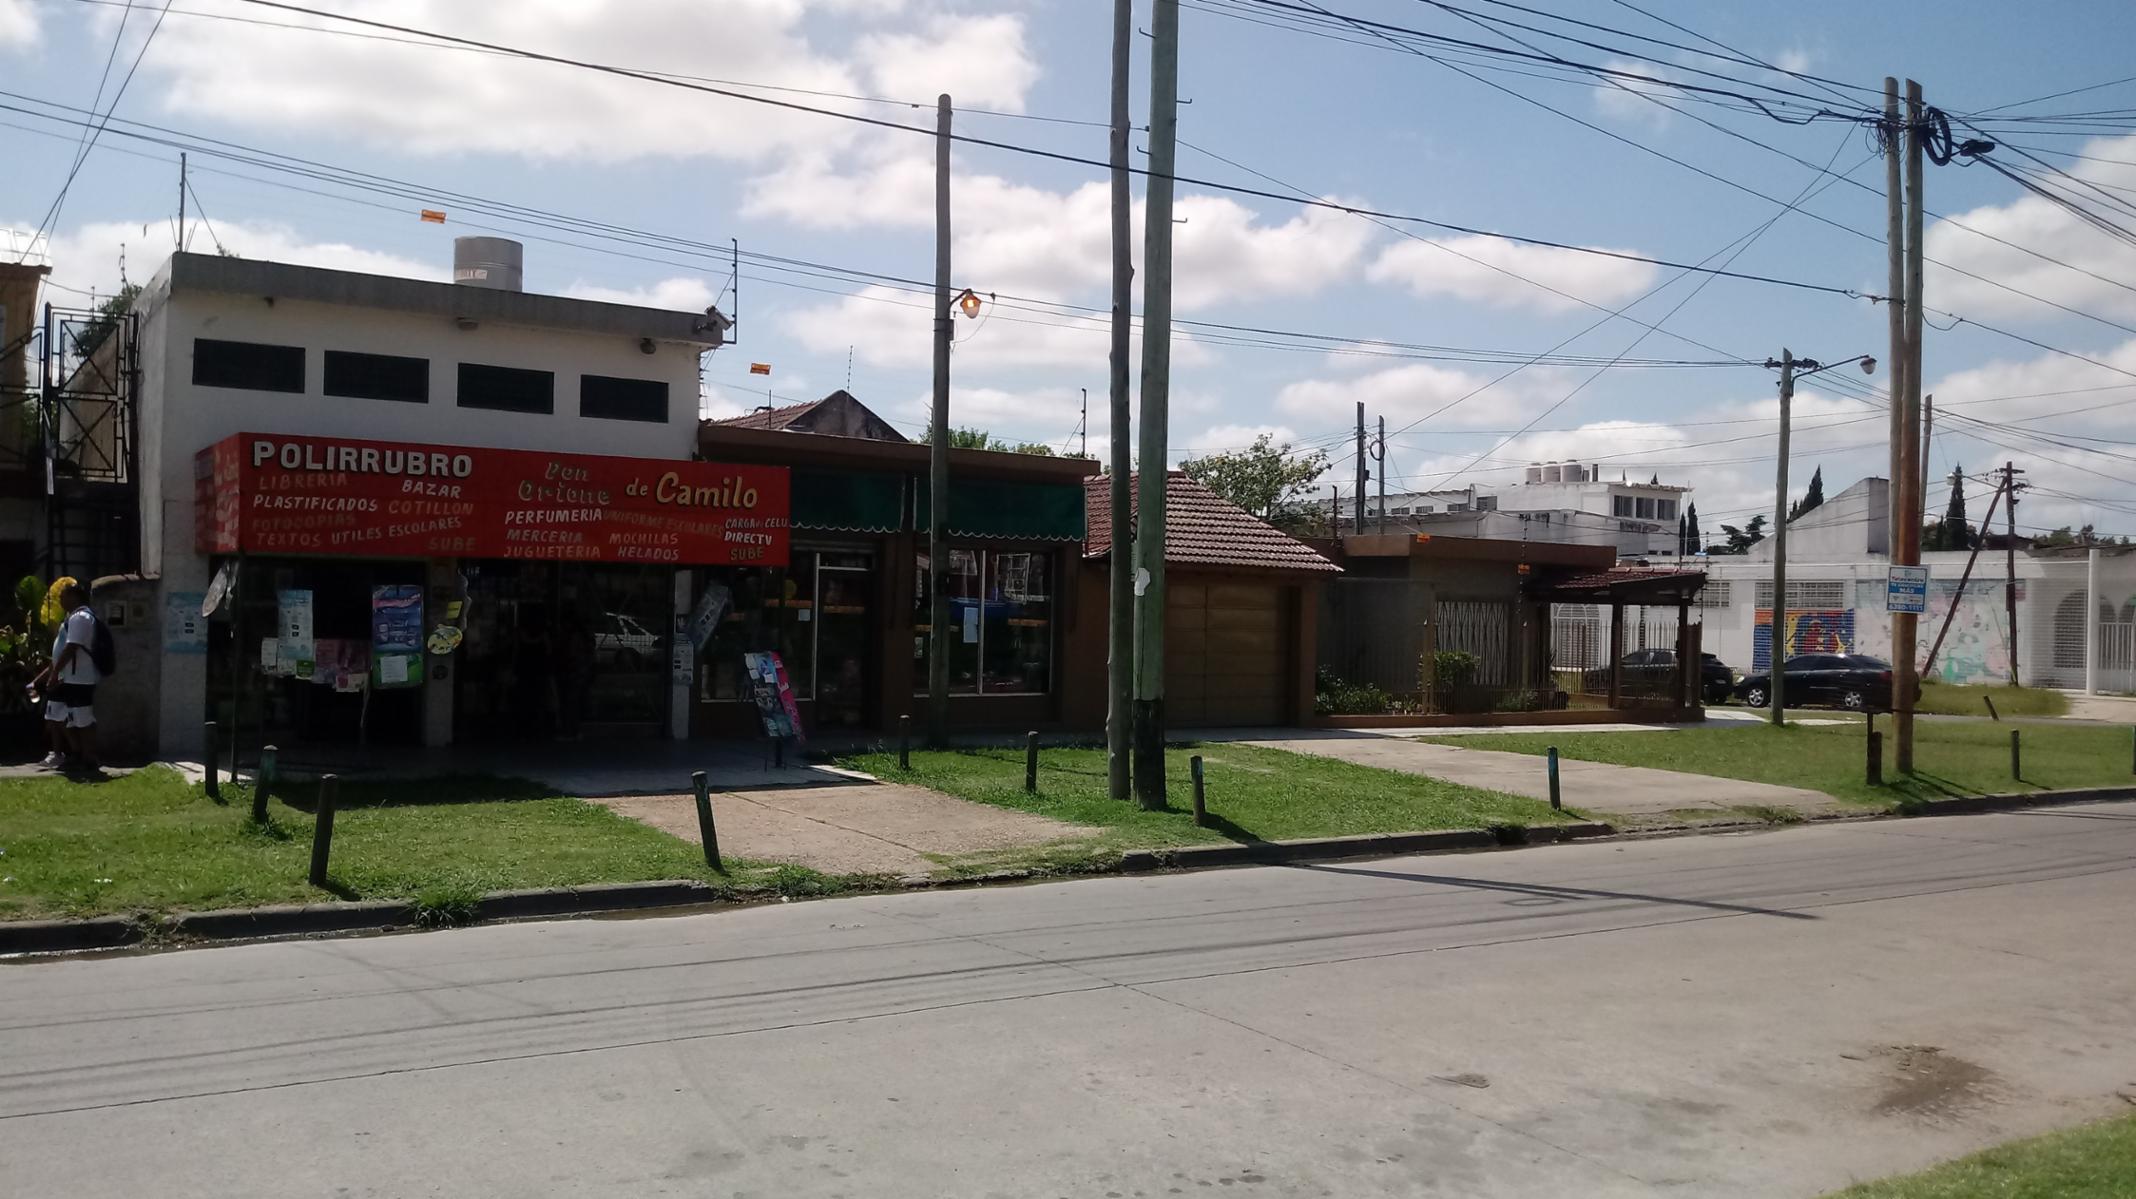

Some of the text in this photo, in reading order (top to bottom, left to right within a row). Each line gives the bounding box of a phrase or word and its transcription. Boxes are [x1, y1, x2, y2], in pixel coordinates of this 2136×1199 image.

[253, 441, 473, 478] POLIRRUBRO
[259, 472, 348, 490] LIBRERIA
[402, 479, 462, 498] BAZAR
[625, 472, 759, 509] de Camilo
[253, 495, 378, 512] PLASTIFICADOS
[388, 501, 473, 516] COTILLON
[504, 508, 602, 525] PERFUMERIA
[725, 518, 755, 529] CARGA
[256, 516, 462, 547] TEXTOS UTILES ESCOLARES
[506, 529, 583, 544] MERCERIA
[609, 532, 679, 545] MOCHILAS
[724, 531, 773, 546] DIRECTV
[428, 537, 477, 551] SUBE
[503, 545, 601, 559] JUGUETERIA
[617, 546, 680, 561] HELADOS
[730, 547, 764, 561] SUBE
